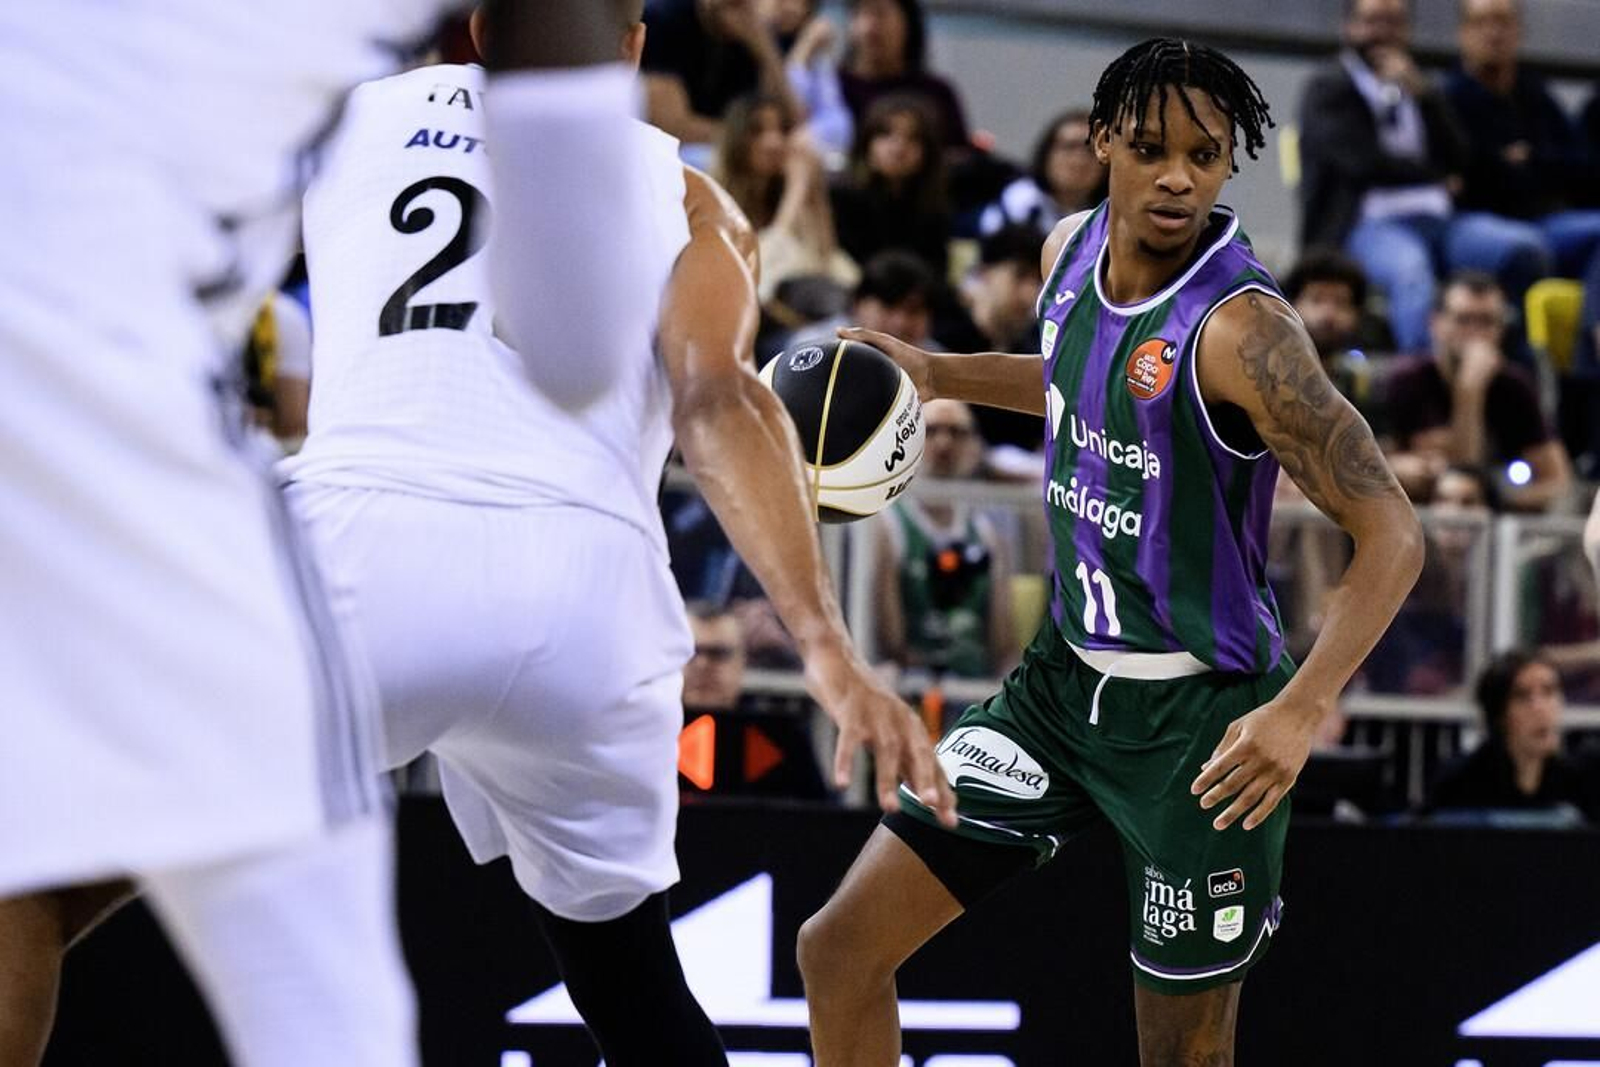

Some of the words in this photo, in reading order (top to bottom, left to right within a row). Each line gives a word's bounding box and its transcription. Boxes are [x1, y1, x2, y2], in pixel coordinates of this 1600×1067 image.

[404, 128, 486, 154] AUT
[895, 418, 917, 449] Rey
[1070, 414, 1161, 480] Unicaja
[1046, 477, 1142, 539] málaga
[1075, 561, 1121, 637] 11
[1213, 880, 1238, 894] acb
